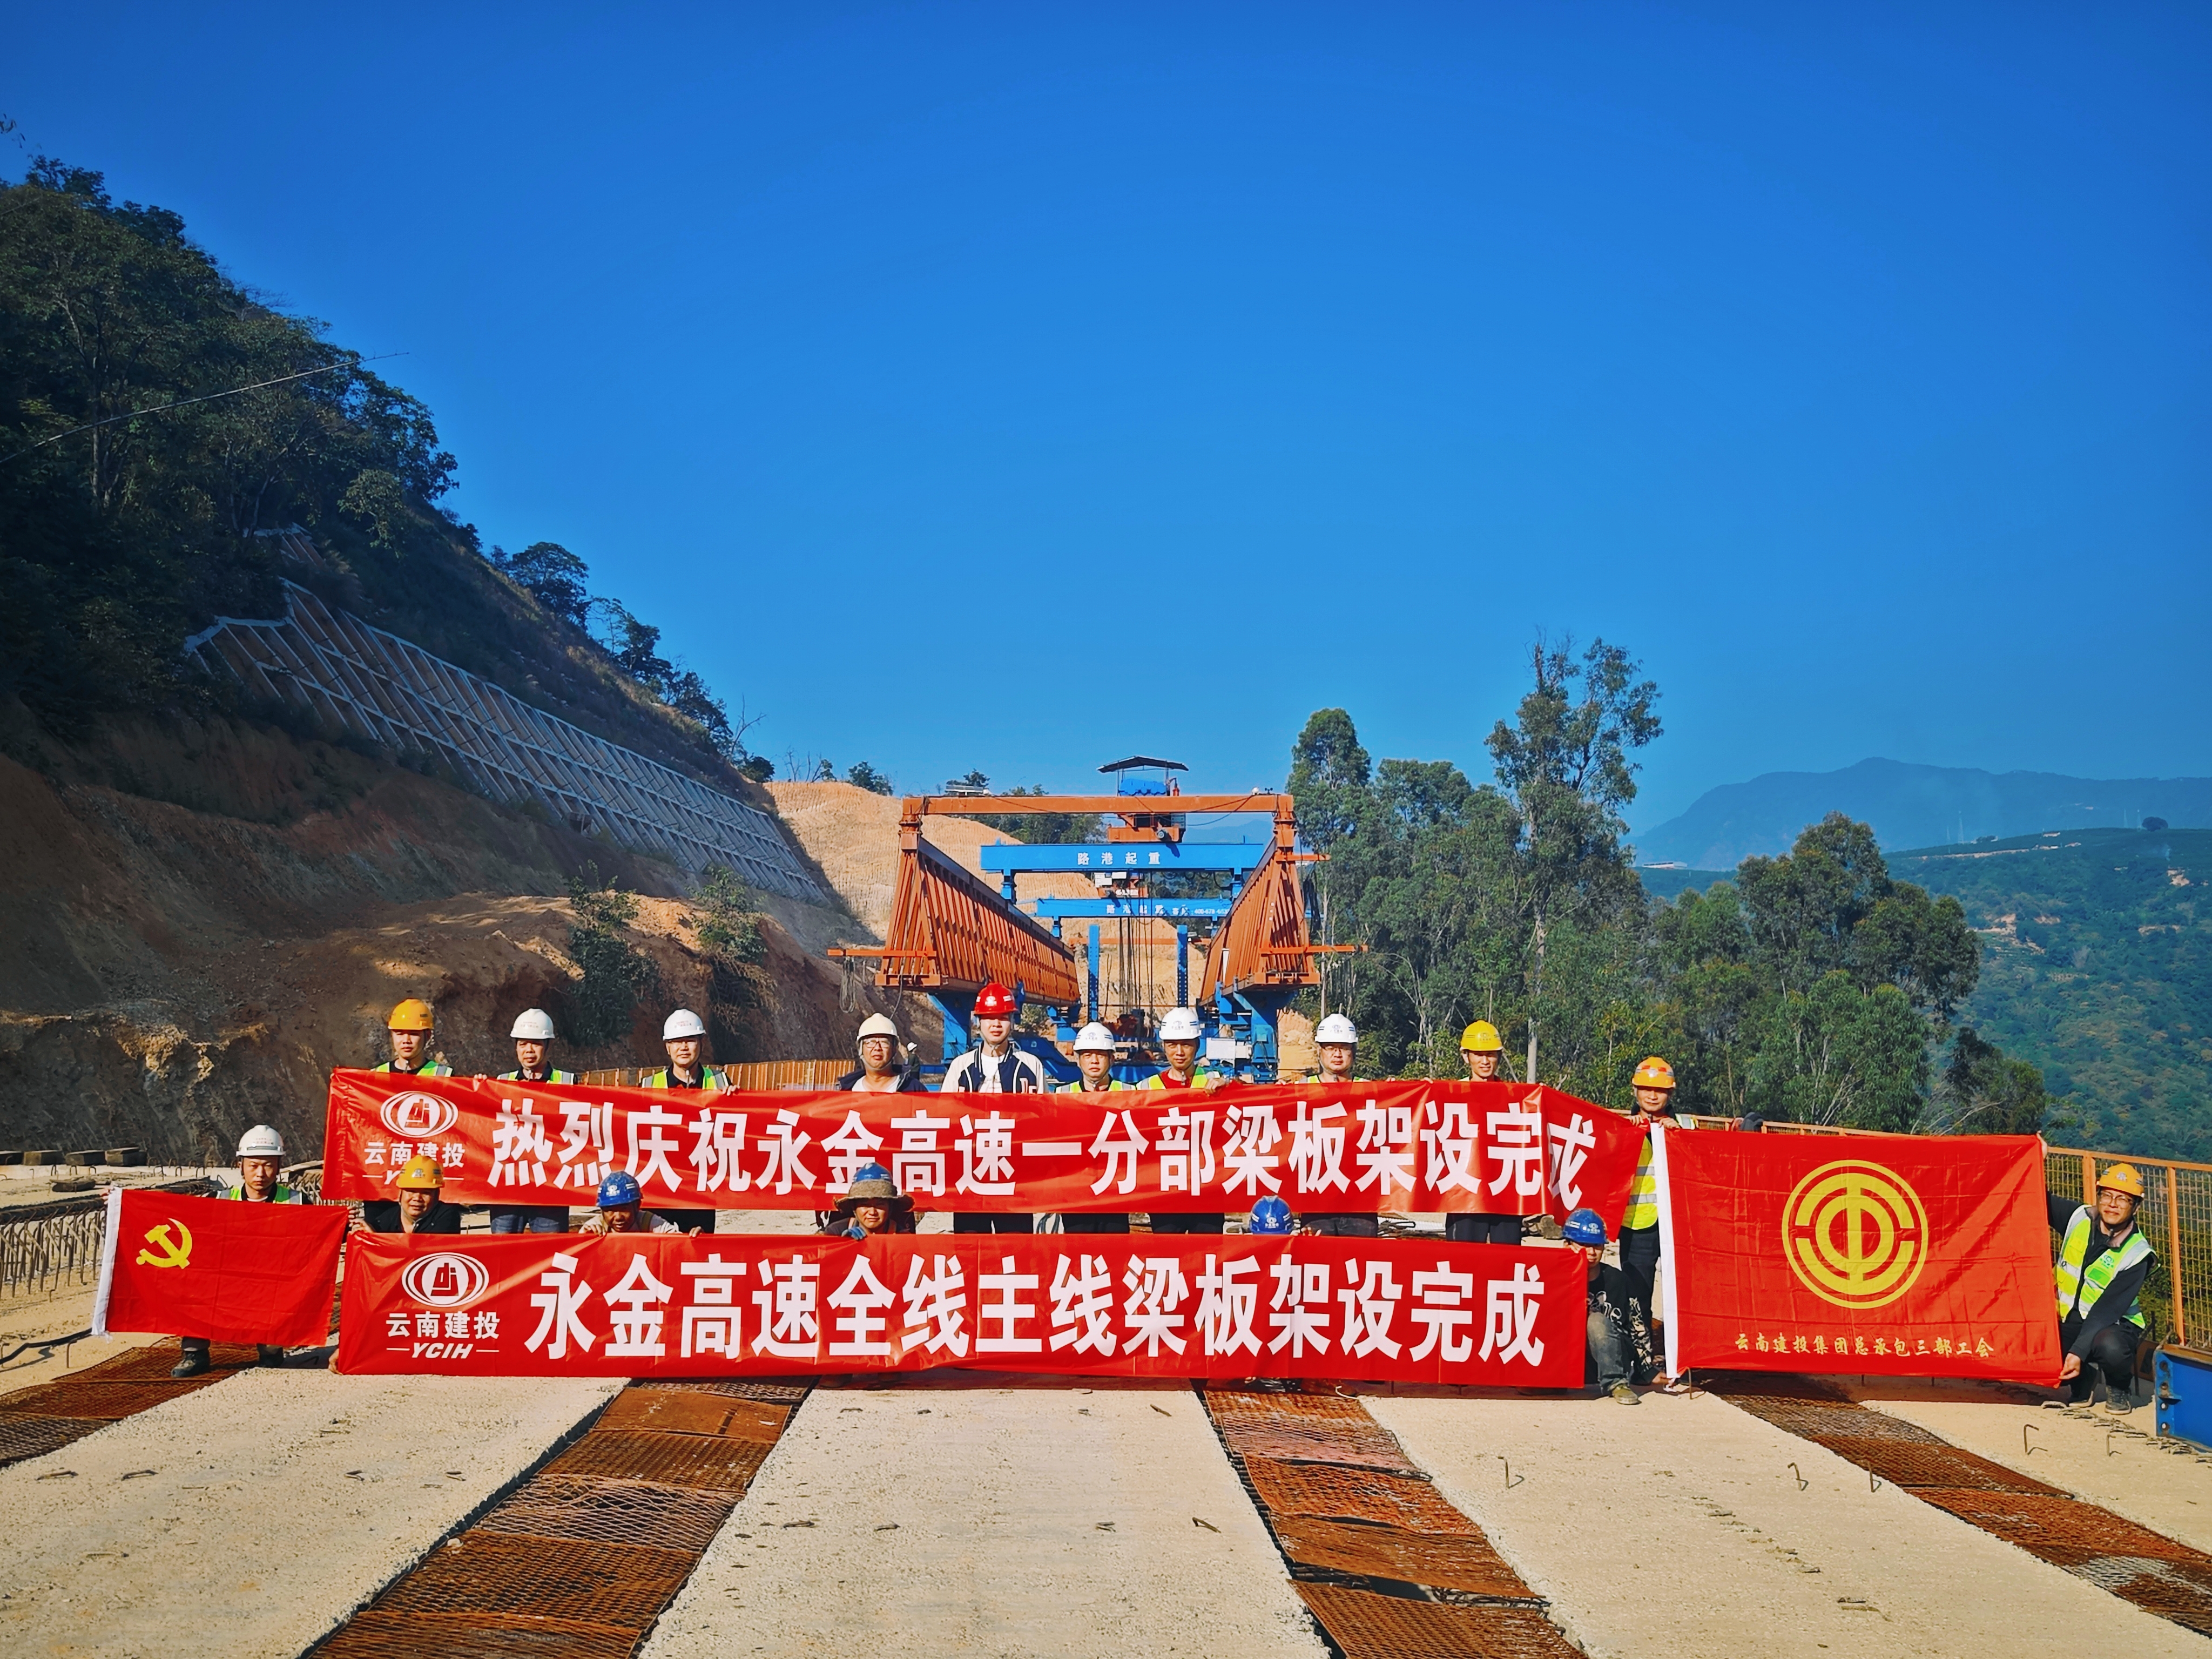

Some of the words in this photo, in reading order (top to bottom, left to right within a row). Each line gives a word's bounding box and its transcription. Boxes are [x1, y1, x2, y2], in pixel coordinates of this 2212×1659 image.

[1077, 852, 1160, 865] 路港起重
[364, 1141, 466, 1168] 云南建投
[488, 1098, 1596, 1211] 热烈庆祝永金高速一分部梁板架设完成
[524, 1252, 1545, 1366] 永金高速全线主线梁板架设完成
[386, 1311, 500, 1339] 云南建投
[412, 1343, 473, 1359] YCIH
[1735, 1332, 1994, 1358] 云南建投集团总承包三部工会
